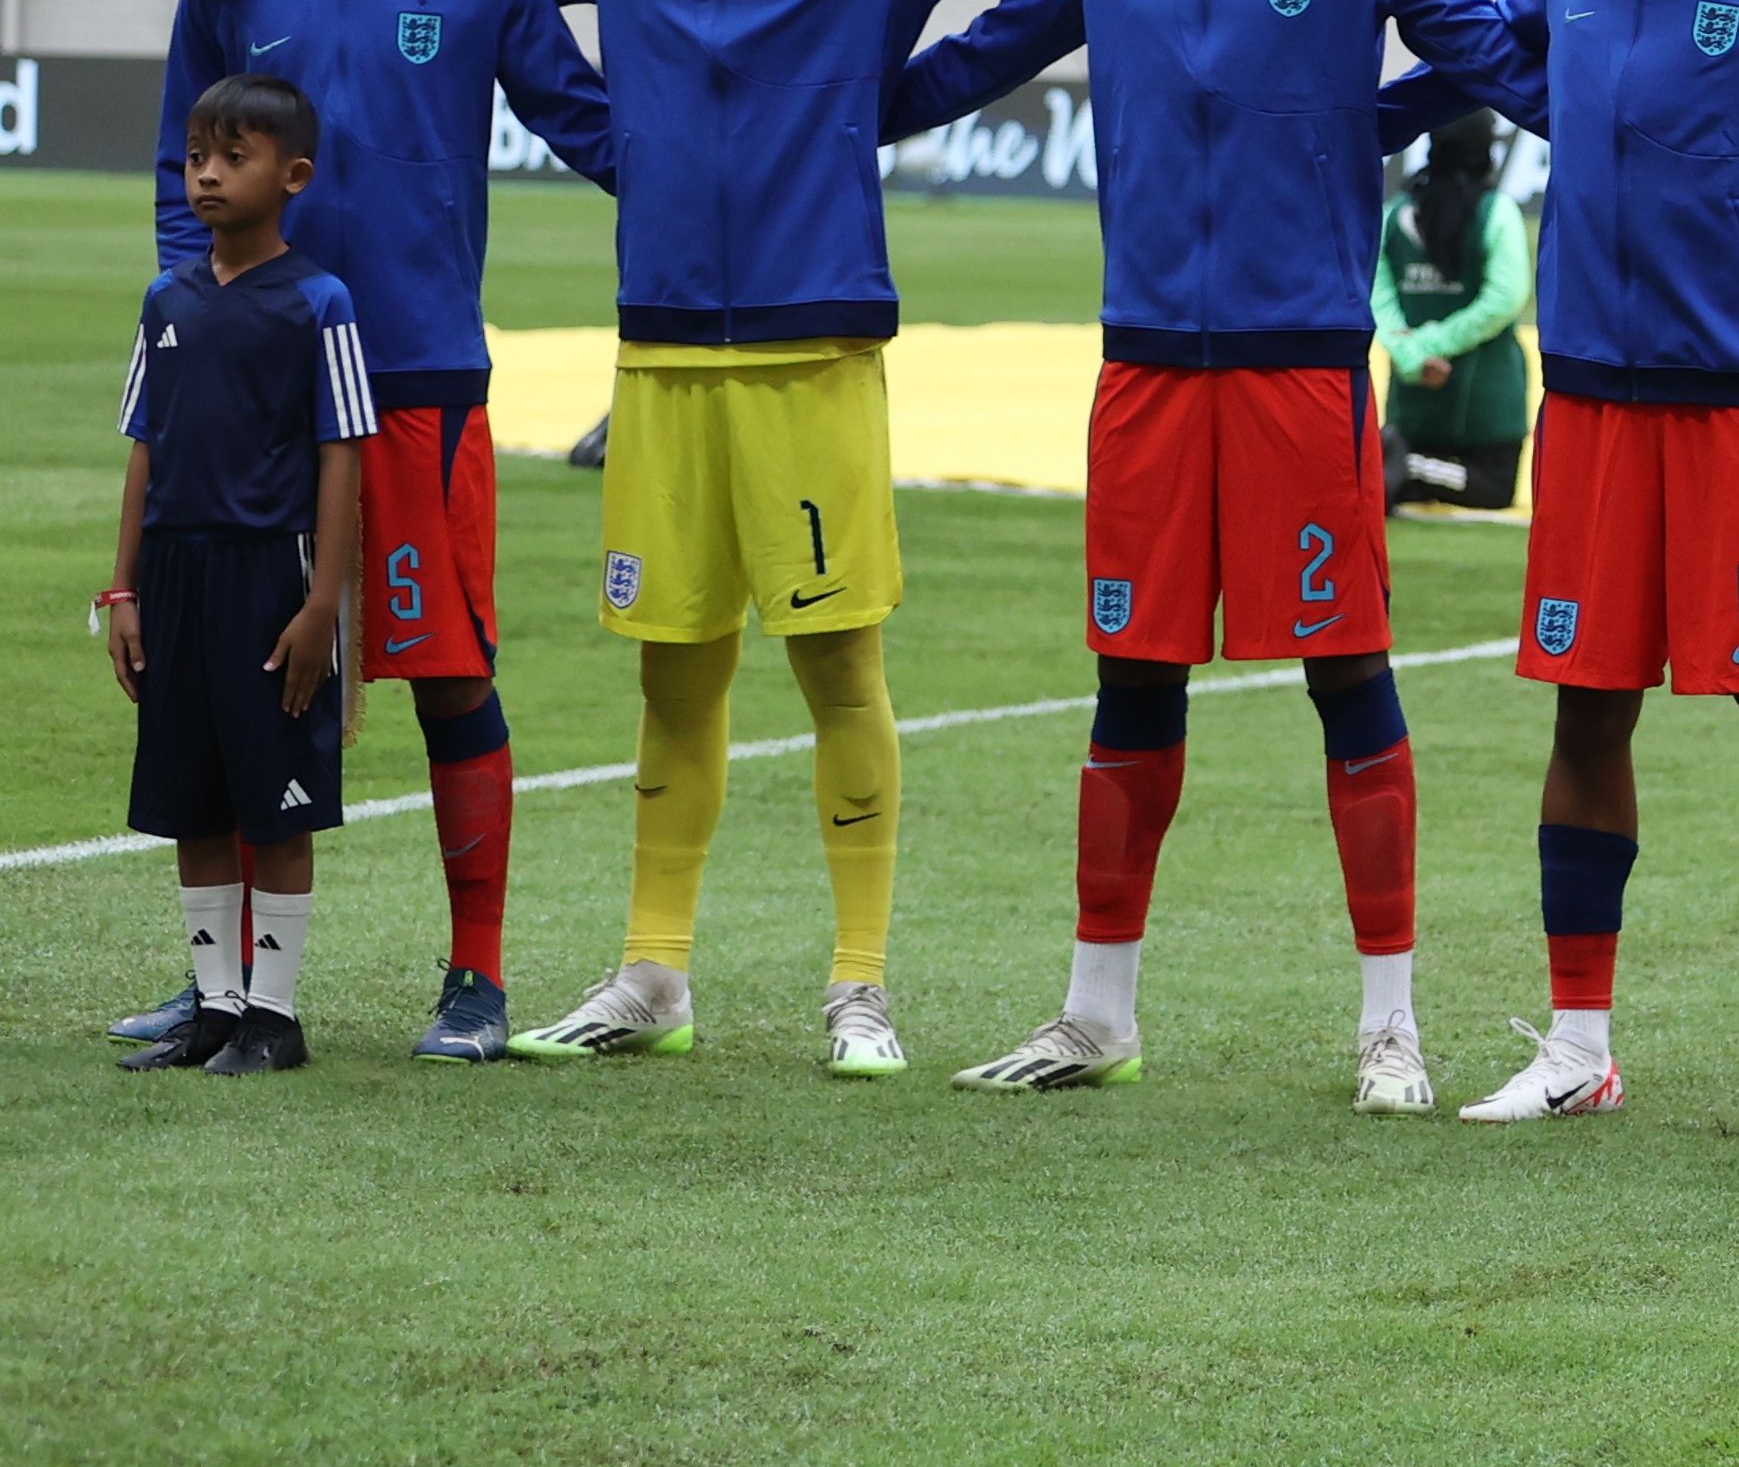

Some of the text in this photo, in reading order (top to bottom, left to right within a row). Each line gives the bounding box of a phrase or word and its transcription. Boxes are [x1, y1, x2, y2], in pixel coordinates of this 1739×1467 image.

[799, 499, 827, 576] 1
[1299, 521, 1335, 603] 2
[386, 542, 422, 620] 5
